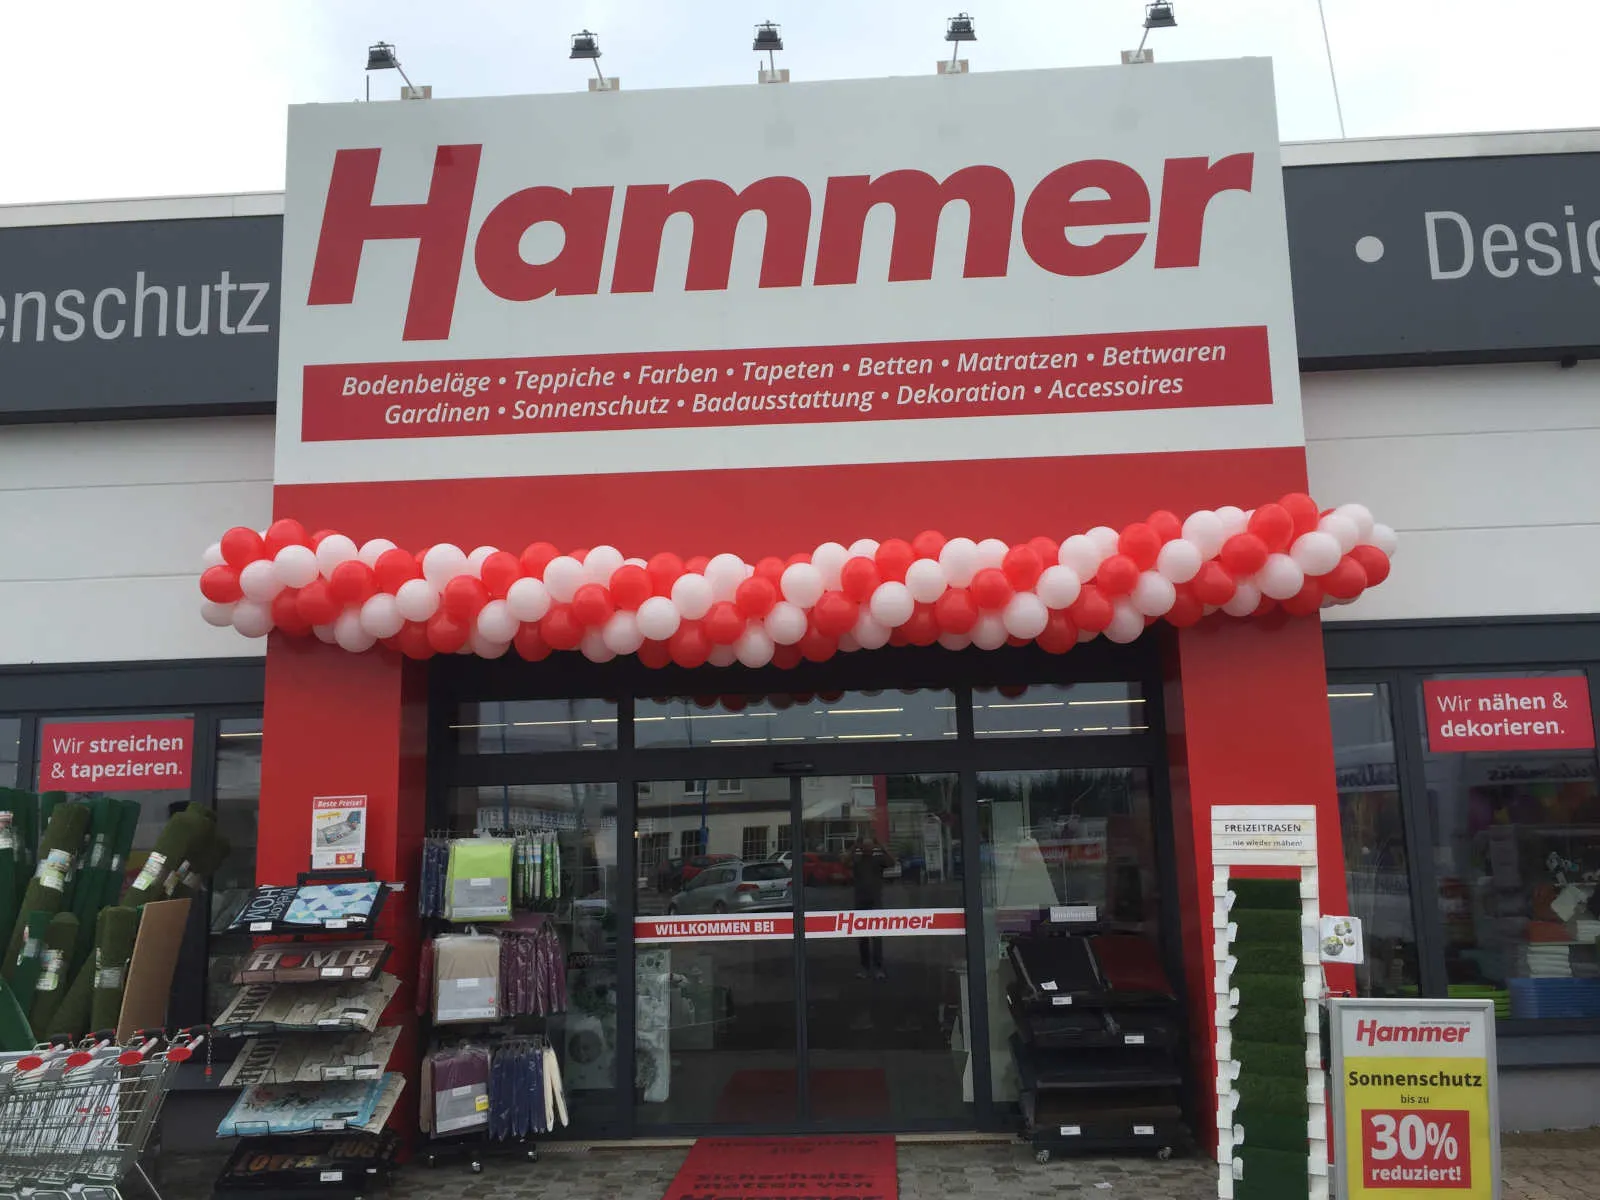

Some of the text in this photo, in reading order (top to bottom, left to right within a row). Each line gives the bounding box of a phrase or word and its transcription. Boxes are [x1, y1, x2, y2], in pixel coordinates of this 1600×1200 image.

[308, 145, 1254, 341] Hammer
[0, 270, 270, 343] nschutz
[341, 345, 1226, 398] Bodenbeläge Teppiche Farben Tapeten Betten Matratzen Bettwaren
[385, 374, 1184, 425] Gardinen Sonnenschutz Badausstattung Dekoration Accessoires
[1437, 691, 1568, 713] Wir nähen &
[1440, 718, 1565, 738] dekorieren.
[52, 734, 183, 755] Wir streichen
[51, 759, 182, 782] & tapezieren.
[1224, 823, 1301, 833] FREIZEITRASEN
[655, 920, 775, 936] WILLKOMMEN BEI
[836, 912, 933, 935] Hammer
[1356, 1019, 1471, 1047] Hammer
[1349, 1071, 1483, 1087] Sonnenschutz
[1400, 1094, 1430, 1104] bis zu
[1370, 1114, 1458, 1161] 30%
[1372, 1165, 1461, 1181] reduziert!
